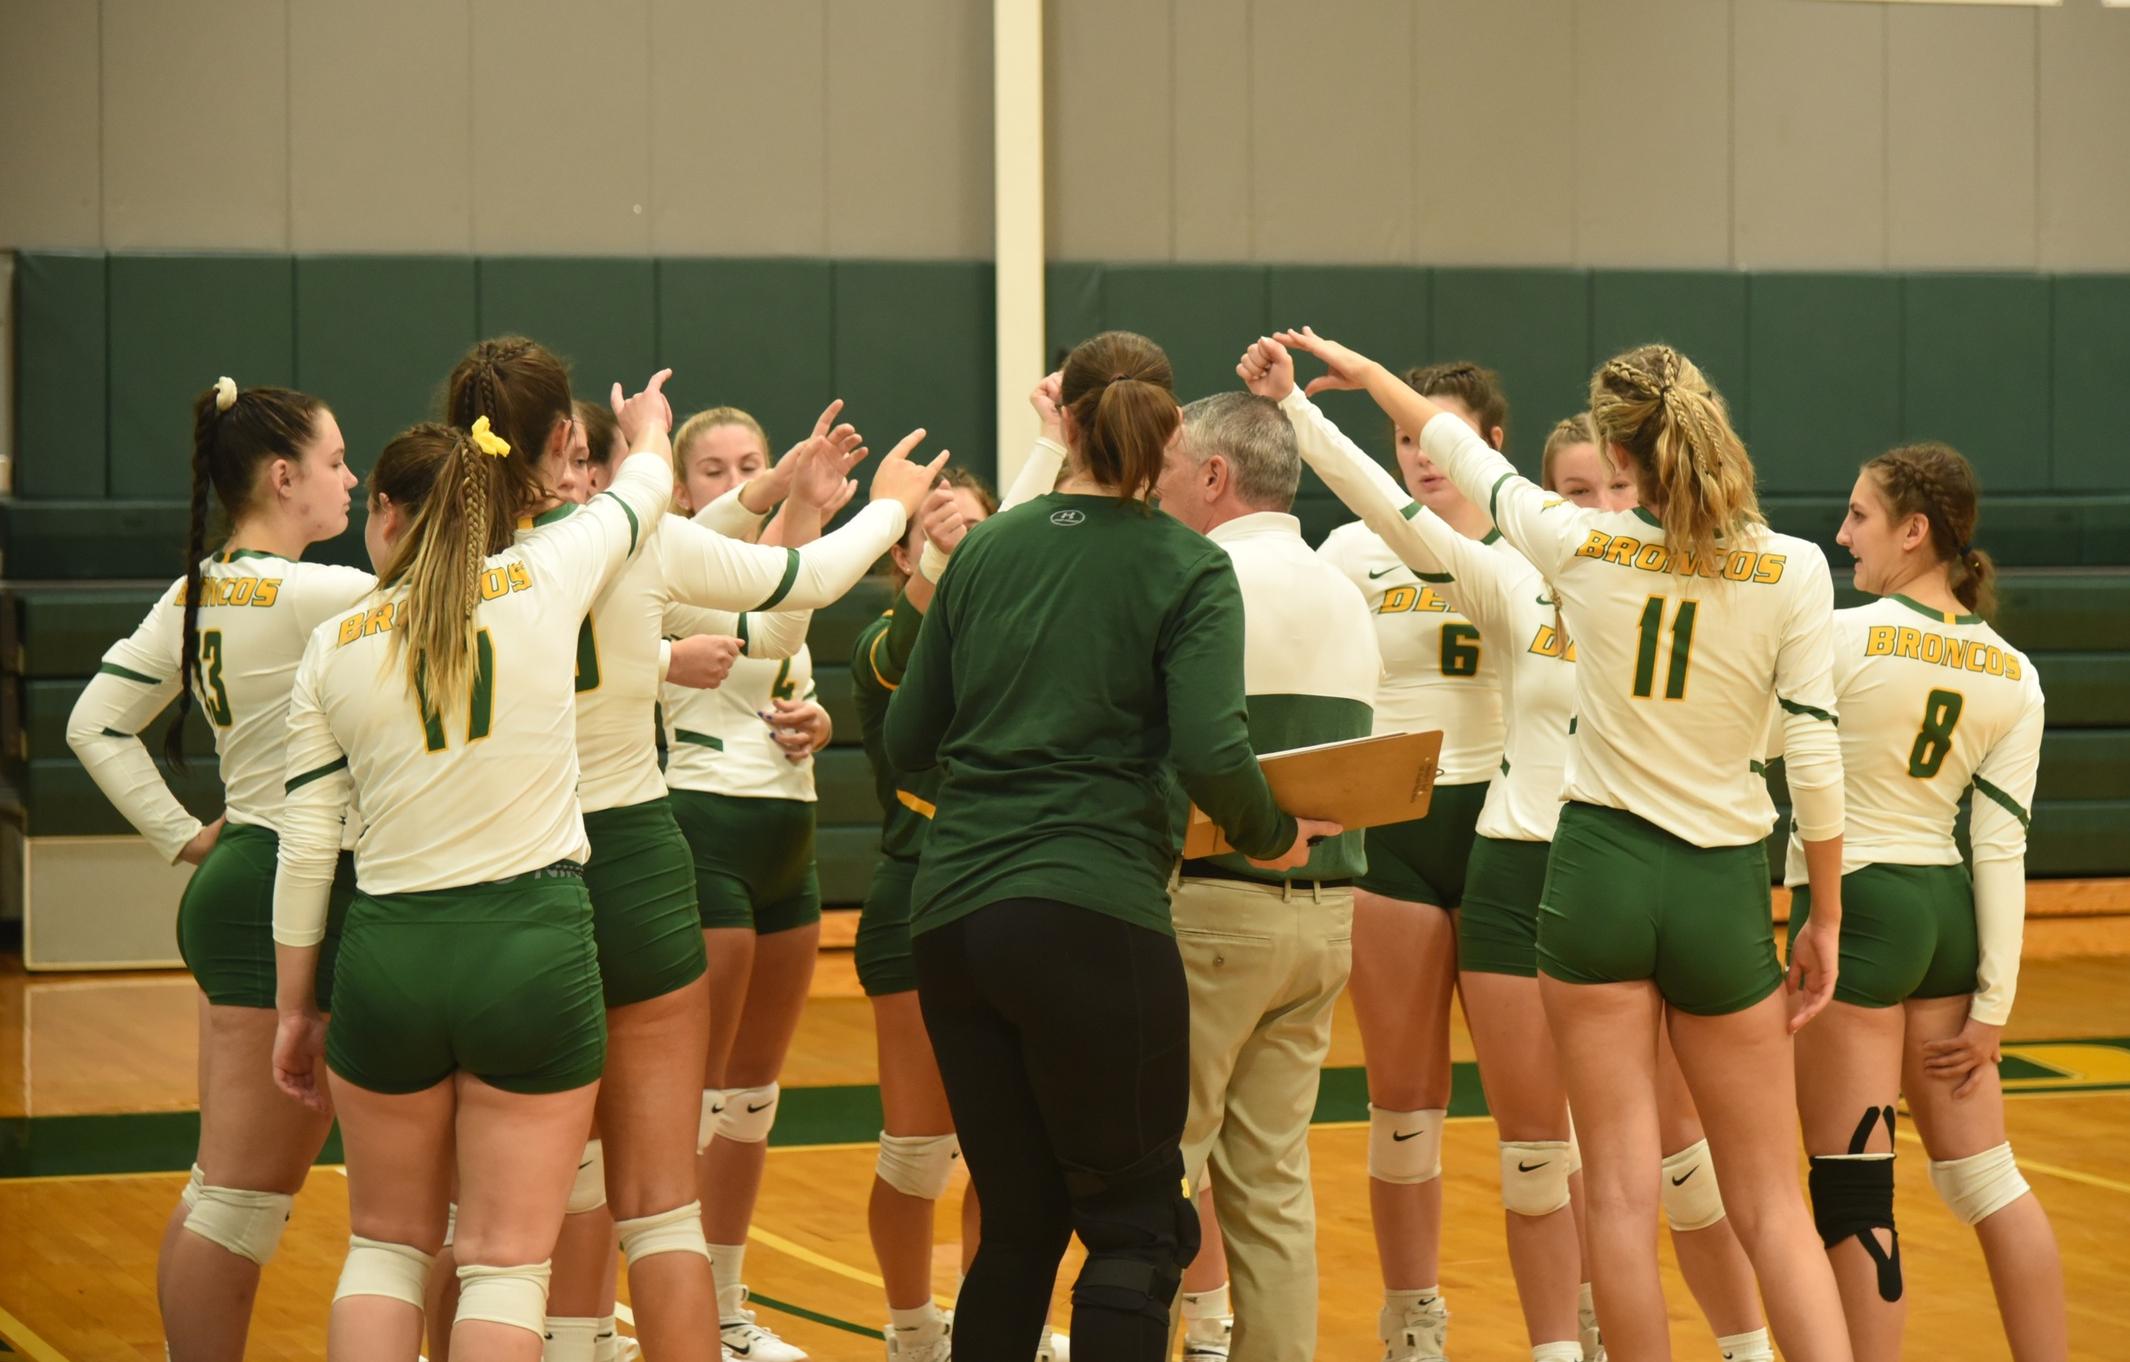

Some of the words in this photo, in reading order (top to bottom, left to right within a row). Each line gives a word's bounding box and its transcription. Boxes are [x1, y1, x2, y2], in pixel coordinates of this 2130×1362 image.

[336, 559, 533, 649] BROS
[1440, 620, 1481, 678] 6
[1631, 593, 1700, 702] 11
[1864, 625, 2022, 682] BRONCOS
[1907, 686, 1966, 781] 8
